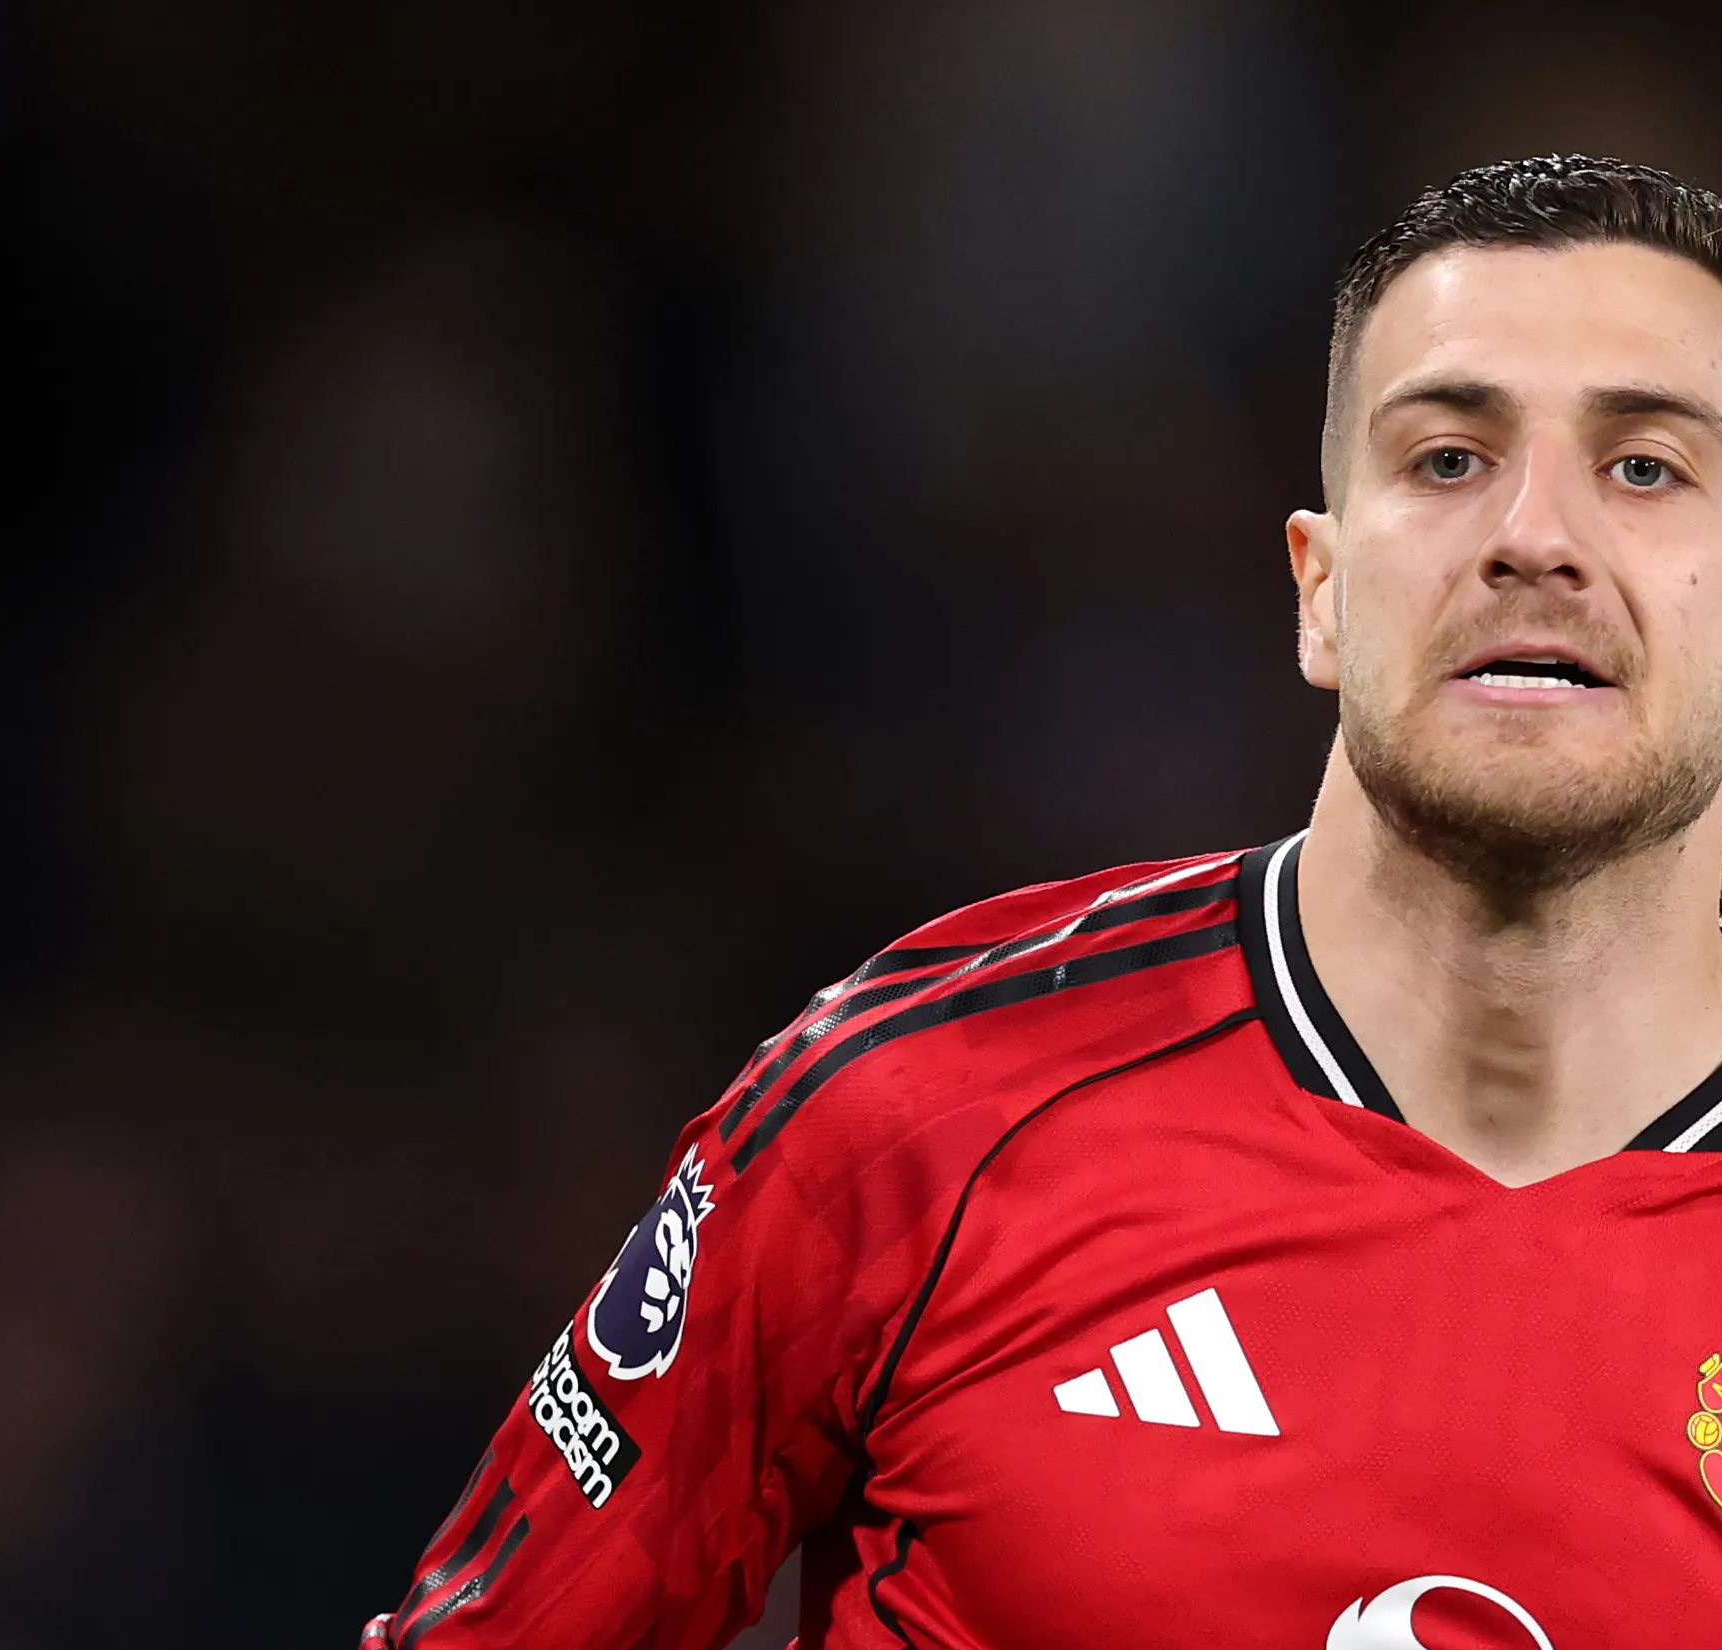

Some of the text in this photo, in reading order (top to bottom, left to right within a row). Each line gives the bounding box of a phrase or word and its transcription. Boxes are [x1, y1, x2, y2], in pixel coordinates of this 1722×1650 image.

[528, 1378, 614, 1509] racism
[549, 1318, 621, 1467] o room
